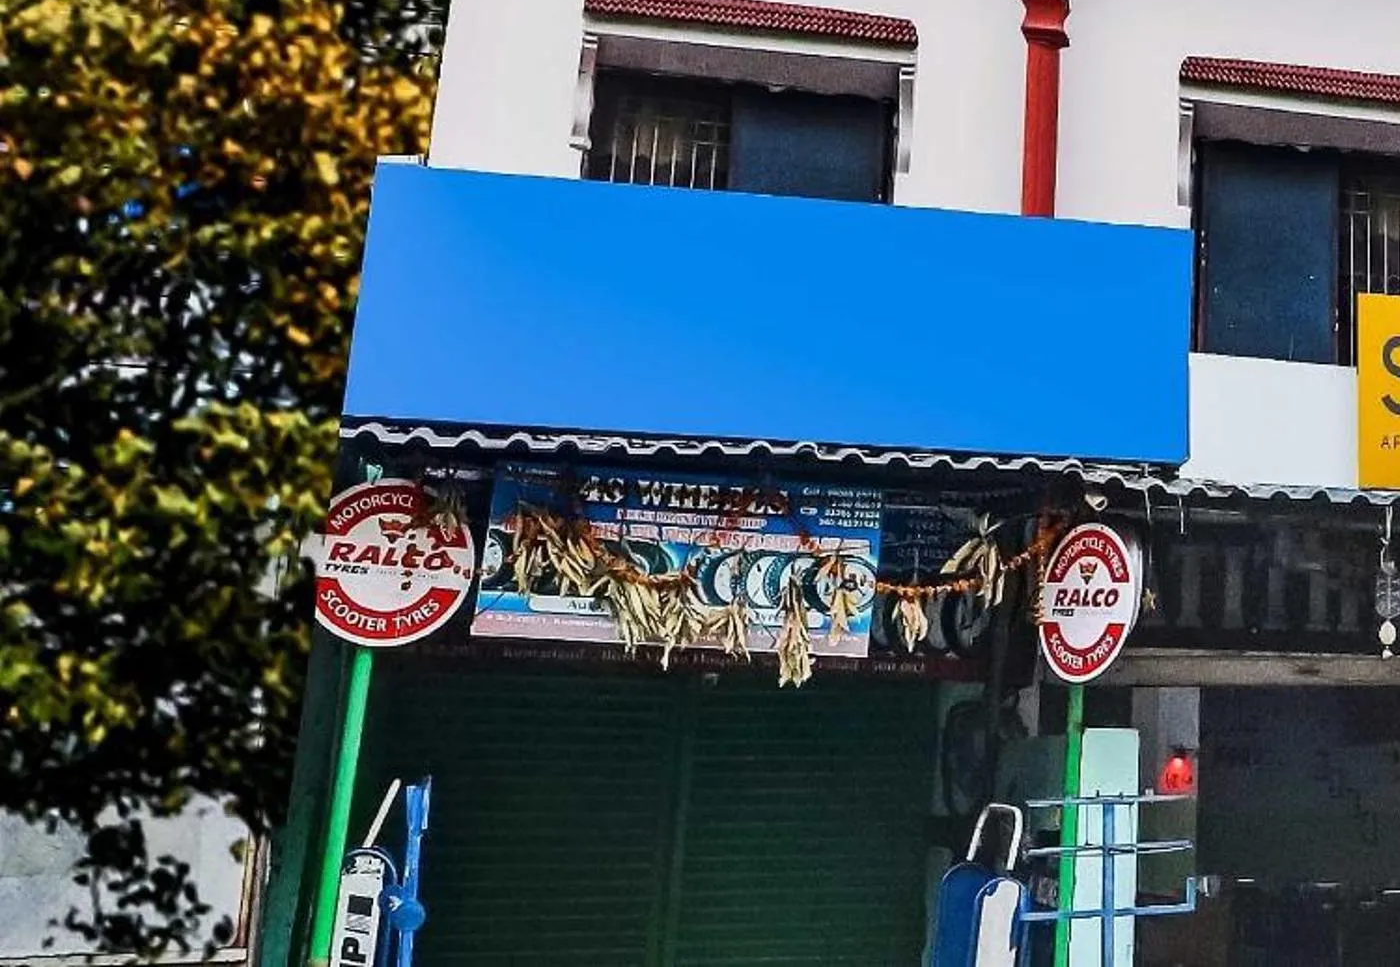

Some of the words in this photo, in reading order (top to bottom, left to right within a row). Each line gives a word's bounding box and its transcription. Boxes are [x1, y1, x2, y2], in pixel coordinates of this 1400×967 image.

[330, 493, 416, 530] MOTORCYCL
[324, 563, 370, 575] TYRES
[329, 542, 454, 571] RALCO
[1054, 537, 1105, 578] MOTORCYCLE
[321, 590, 387, 632] SCOOTER
[392, 598, 440, 630] TYRES
[1054, 588, 1119, 607] RALCO
